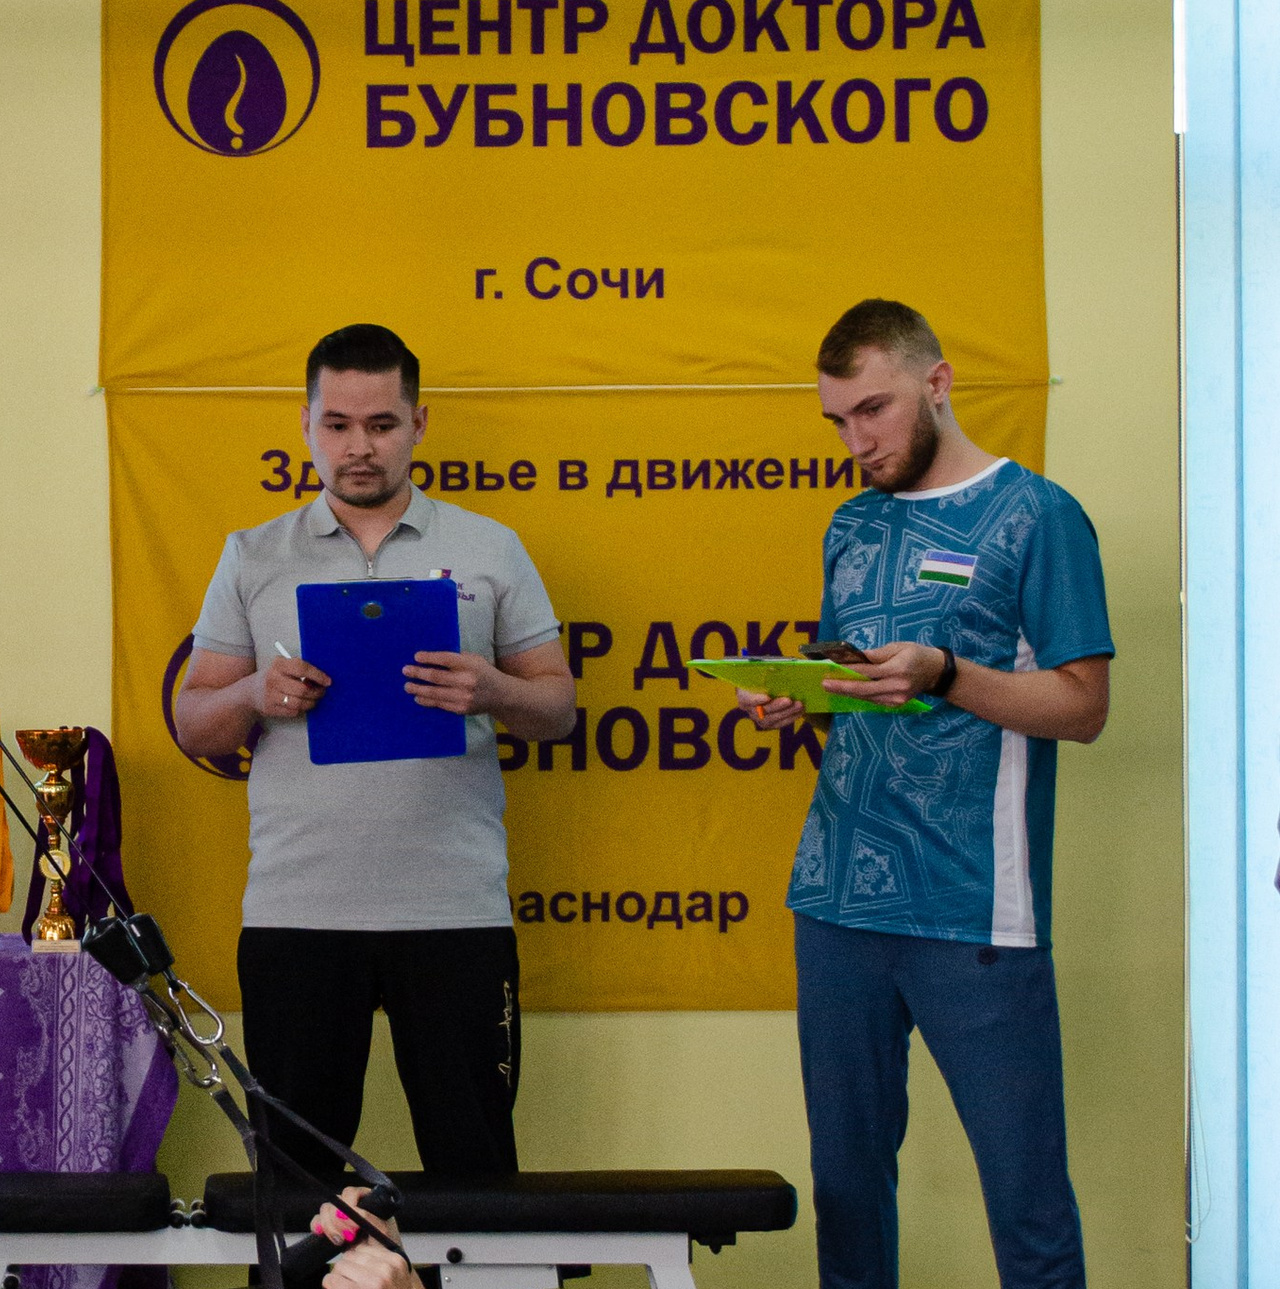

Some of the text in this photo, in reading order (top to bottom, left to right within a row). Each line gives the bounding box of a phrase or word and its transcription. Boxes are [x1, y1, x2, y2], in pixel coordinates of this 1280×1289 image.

[366, 76, 990, 149] БУБНОВСКОГО
[475, 256, 665, 300] г. Сочи
[260, 449, 874, 500] Здовье в движени
